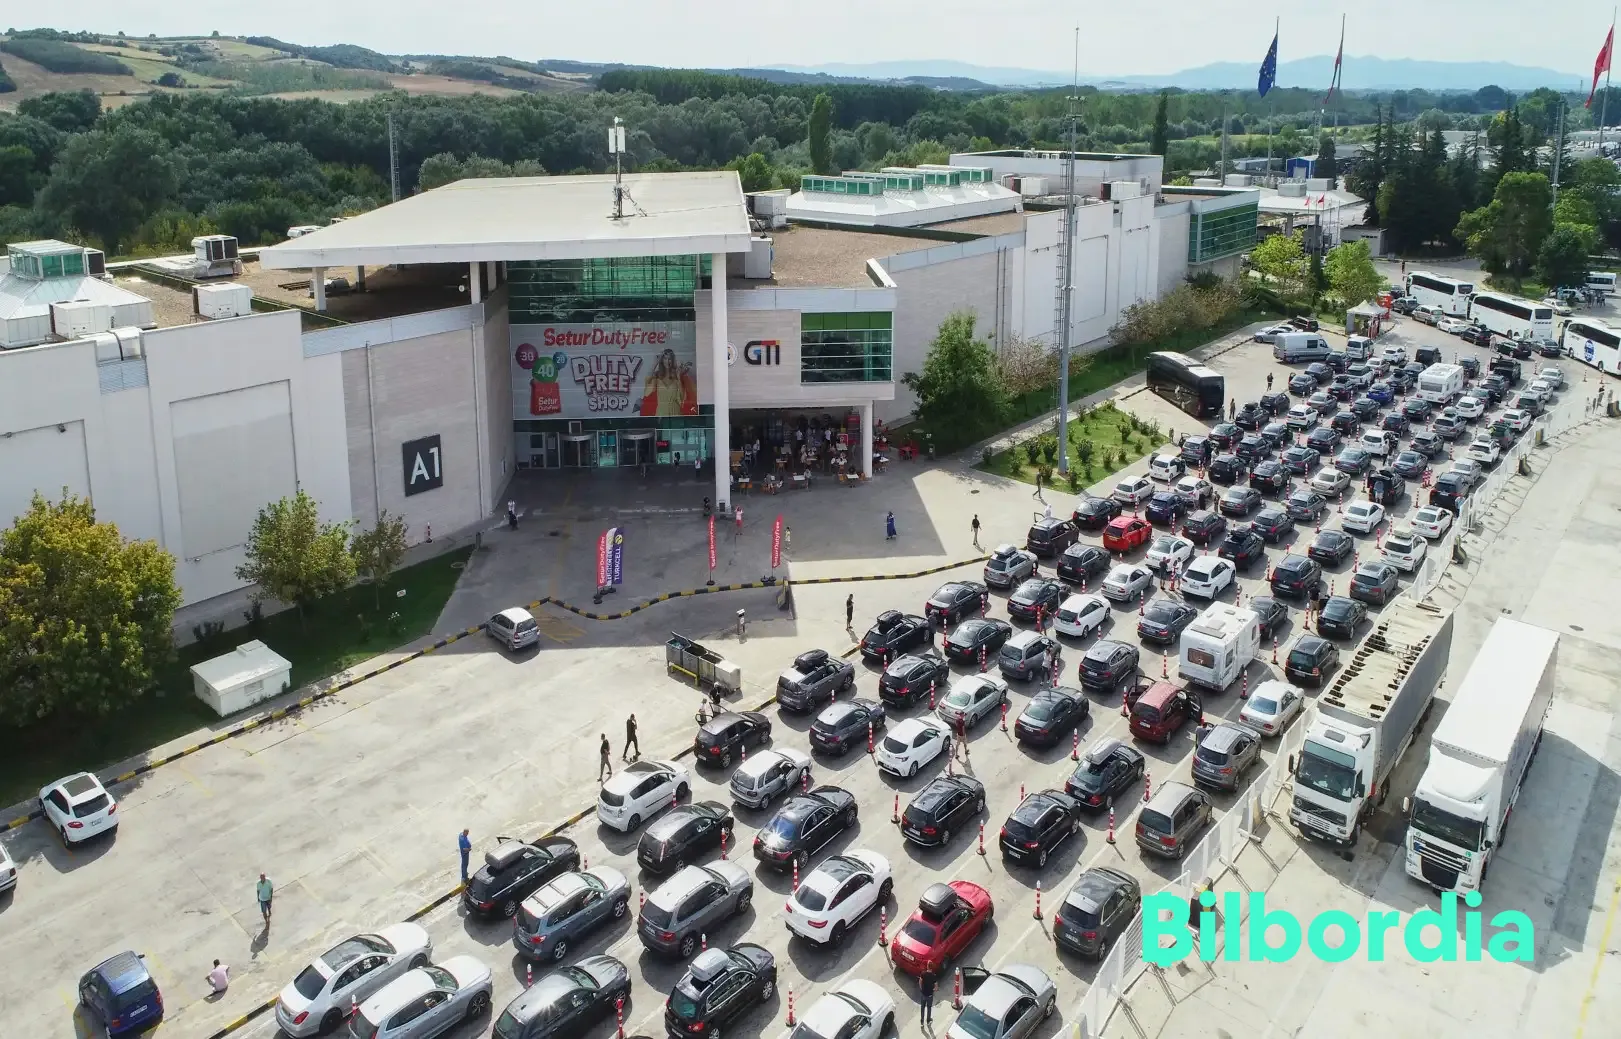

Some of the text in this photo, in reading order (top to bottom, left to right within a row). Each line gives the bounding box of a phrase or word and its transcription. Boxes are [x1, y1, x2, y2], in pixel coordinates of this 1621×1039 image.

[744, 339, 781, 365] GTI
[571, 354, 643, 383] DUTY
[585, 374, 631, 394] FREE
[538, 396, 559, 405] Setur
[588, 395, 629, 411] SHOP
[410, 447, 440, 485] A1
